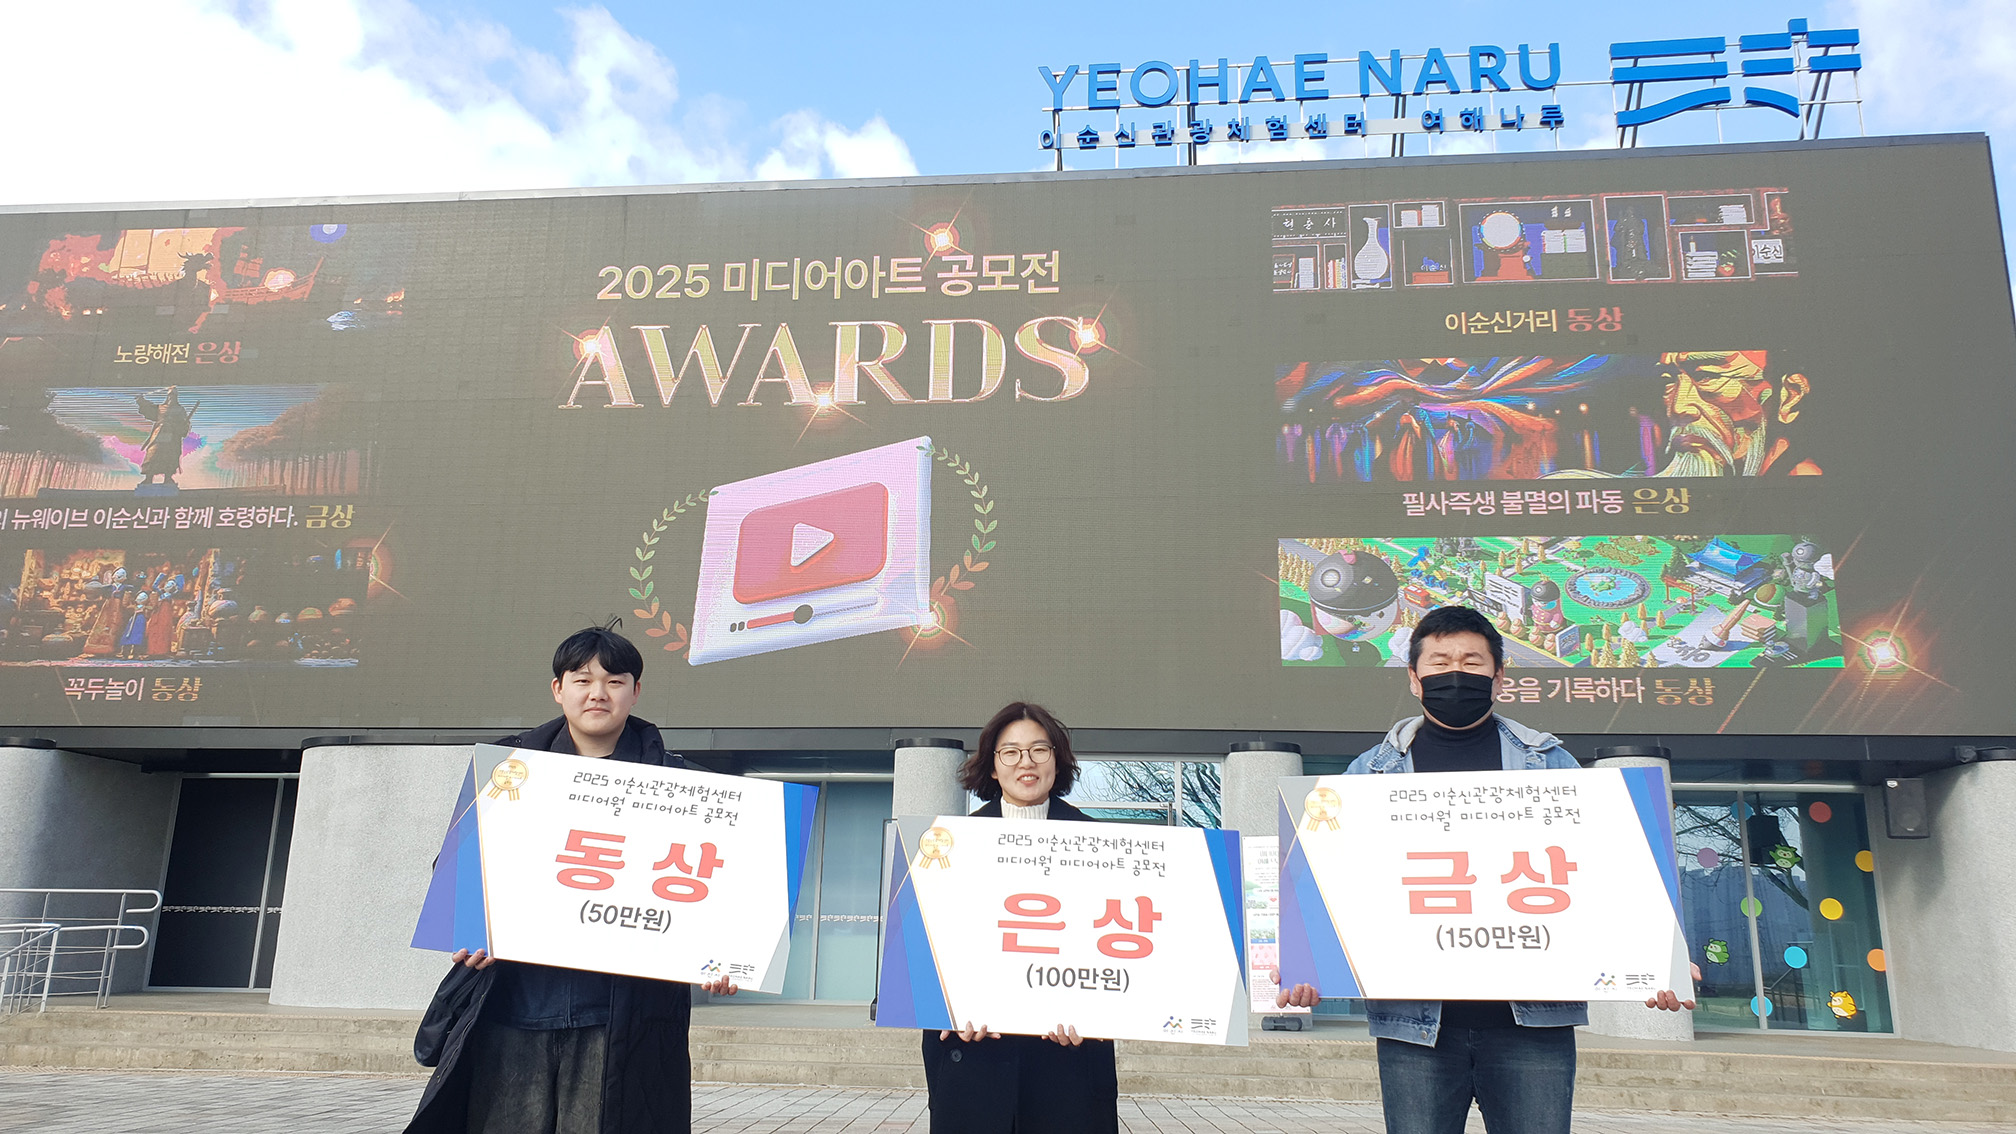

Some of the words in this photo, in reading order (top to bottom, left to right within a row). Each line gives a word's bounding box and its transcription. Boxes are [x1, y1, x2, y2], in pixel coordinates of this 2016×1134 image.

[1038, 53, 1329, 111] YEOHAE
[1358, 43, 1561, 97] NARU
[1040, 110, 1366, 149] 이순신관광체험센터
[1421, 104, 1564, 134] 여해나루
[597, 264, 710, 300] 2025
[723, 256, 926, 300] 미디어아트
[937, 251, 1061, 296] 공모전
[1445, 308, 1558, 335] 이순신거리
[1567, 307, 1624, 332] 동상
[114, 343, 190, 365] 노량해전
[194, 341, 241, 364] 은상
[558, 316, 1090, 409] AWARDS
[1403, 489, 1496, 516] 필사즉생
[1500, 489, 1571, 515] 불멸의
[1576, 488, 1624, 514] 파동
[1632, 487, 1691, 514] 은상
[11, 507, 88, 530] 뉴웨이브
[94, 506, 170, 530] 이순신과
[174, 506, 213, 530] 함께
[216, 505, 298, 529] 호령하다.
[305, 504, 355, 529] 금상
[64, 677, 144, 701] 꼭두놀이
[151, 676, 202, 702] 동상
[1547, 677, 1645, 704] 기록하다
[1654, 677, 1716, 706] 동상
[573, 771, 609, 787] 2025
[614, 777, 742, 805] 이순신관광체험센터
[1389, 789, 1427, 802] 2025
[1433, 785, 1577, 806] 이순신관광체험센터
[569, 793, 625, 817] 미디어월
[632, 801, 698, 816] 미디어아트
[704, 807, 738, 827] 공모전
[1391, 809, 1451, 831] 미디어월
[1461, 806, 1534, 821] 미디어아트
[1543, 806, 1581, 825] 공모전
[998, 833, 1033, 847] 2025
[1038, 834, 1165, 855] 이순신관광체험센터
[997, 855, 1052, 876] 미디어월
[1060, 857, 1126, 870] 미디어아트
[1132, 859, 1166, 878] 공모전
[580, 899, 672, 934] (50만원)
[1436, 924, 1552, 952] (150만원)
[1026, 963, 1130, 994] (100만원)
